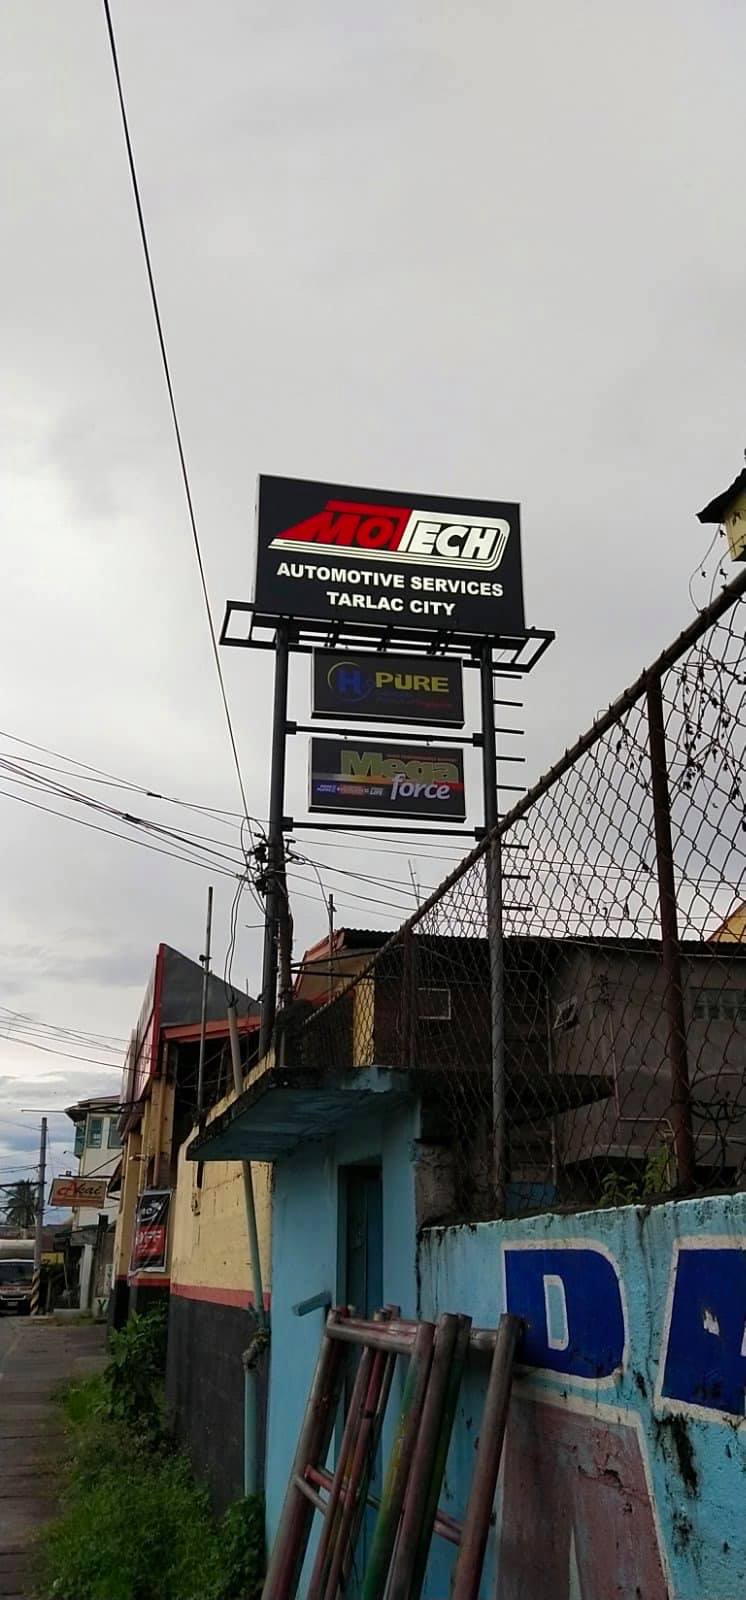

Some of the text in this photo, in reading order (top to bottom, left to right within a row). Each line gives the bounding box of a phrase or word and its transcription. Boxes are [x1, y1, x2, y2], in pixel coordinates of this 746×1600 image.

[276, 562, 504, 597] AUTOMOTIVE SERVICES
[326, 591, 456, 616] TARLAC CITY
[375, 671, 450, 694] PURE
[340, 750, 460, 786] Mega
[391, 773, 451, 801] force
